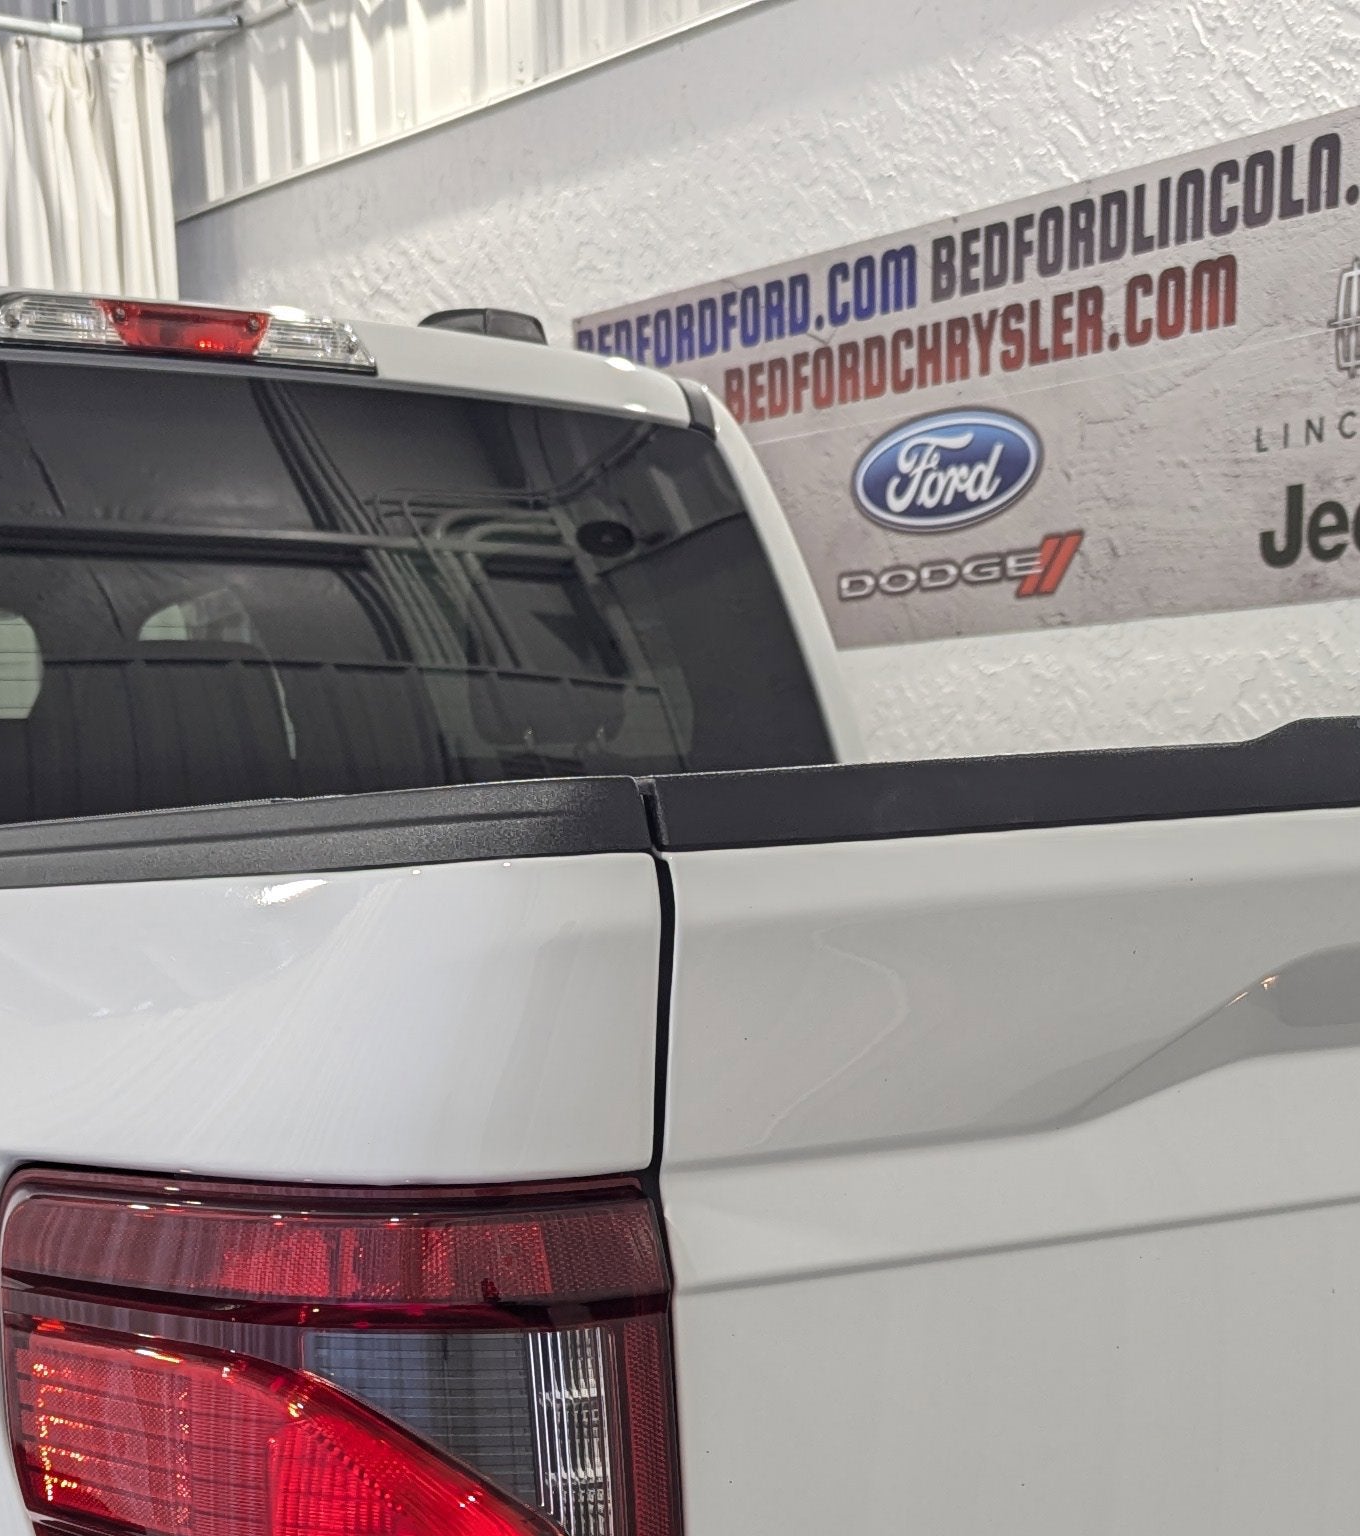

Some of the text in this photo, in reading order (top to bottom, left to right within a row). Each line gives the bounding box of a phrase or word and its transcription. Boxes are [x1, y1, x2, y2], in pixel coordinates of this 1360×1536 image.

[724, 254, 1237, 425] BEDFORDCHRYSLER.COM
[886, 432, 1004, 513] Ford
[839, 546, 1044, 601] DODGE
